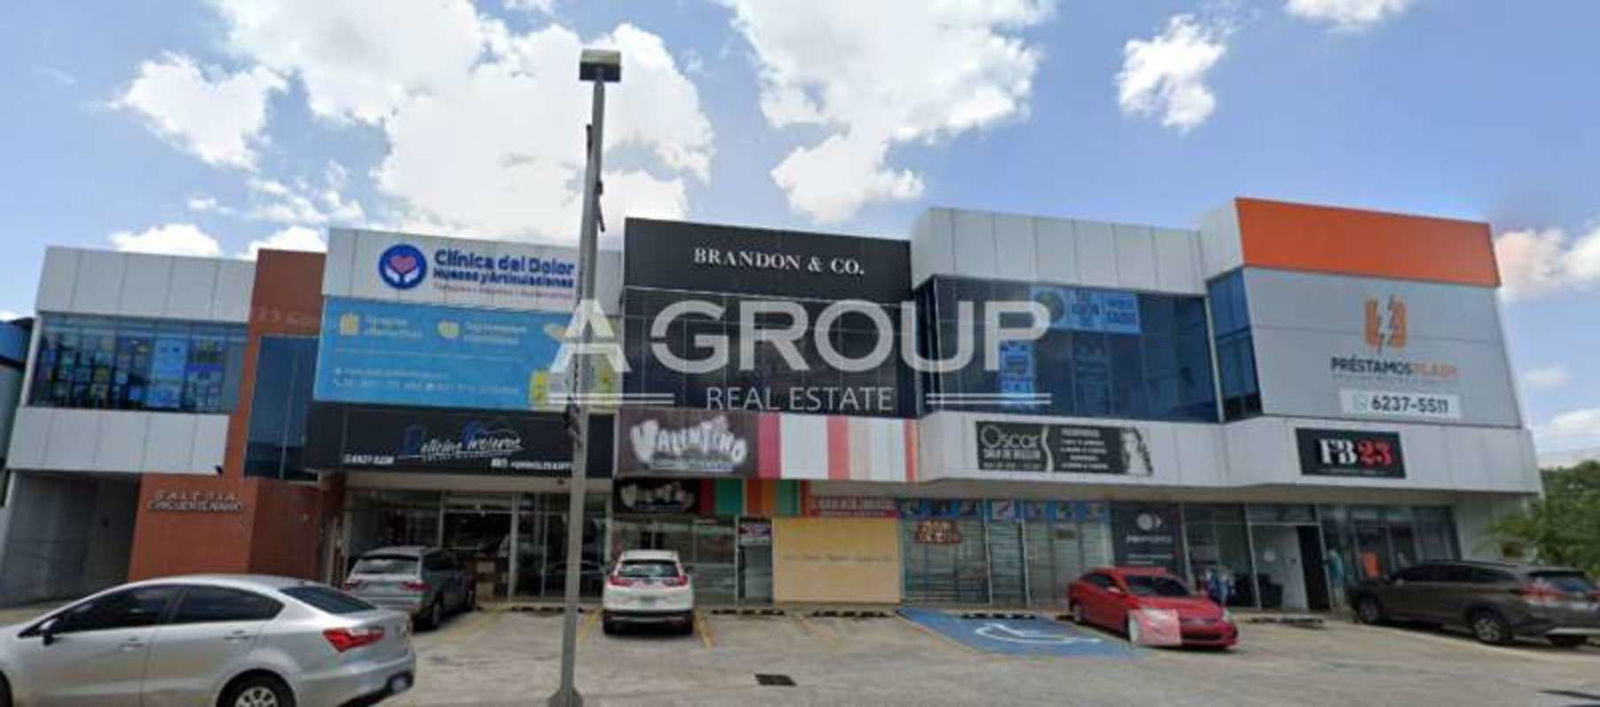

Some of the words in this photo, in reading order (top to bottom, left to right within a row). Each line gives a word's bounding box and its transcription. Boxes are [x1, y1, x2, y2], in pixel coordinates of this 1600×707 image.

[434, 248, 496, 269] Clínica
[497, 255, 526, 272] del
[528, 257, 575, 276] Dolor
[694, 247, 800, 271] BRANDON
[806, 255, 823, 273] &
[830, 257, 866, 276] CO.
[1371, 394, 1449, 414] 6237-5511
[630, 415, 747, 464] VALENTINO
[1319, 438, 1393, 467] FB23
